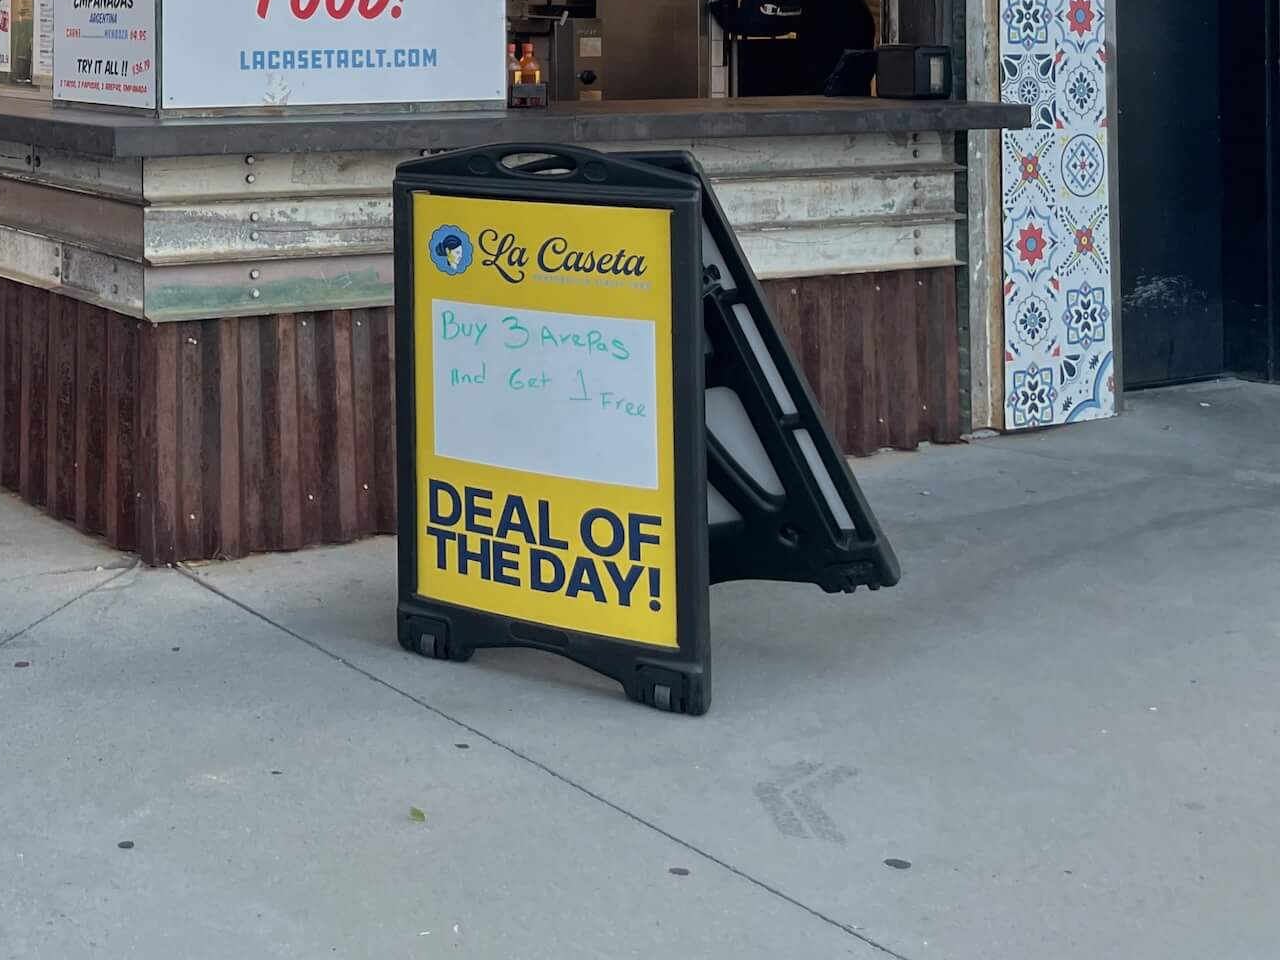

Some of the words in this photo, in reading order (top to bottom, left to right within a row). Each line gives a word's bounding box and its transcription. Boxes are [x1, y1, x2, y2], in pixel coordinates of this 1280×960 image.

[88, 12, 118, 25] ARGENTINA
[77, 58, 93, 74] TRY
[94, 59, 103, 74] IT
[104, 60, 119, 76] ALL
[239, 49, 438, 71] LACASETACLT.COM
[477, 228, 529, 284] La
[536, 236, 648, 277] Caseta
[440, 309, 488, 345] Buy
[500, 316, 530, 349] 3
[508, 368, 553, 390] Get
[568, 368, 593, 401] 1
[600, 392, 647, 418] Free
[428, 478, 568, 551] DEAL
[579, 507, 663, 563] OF
[425, 526, 521, 588] THE
[529, 545, 662, 613] DAY!
